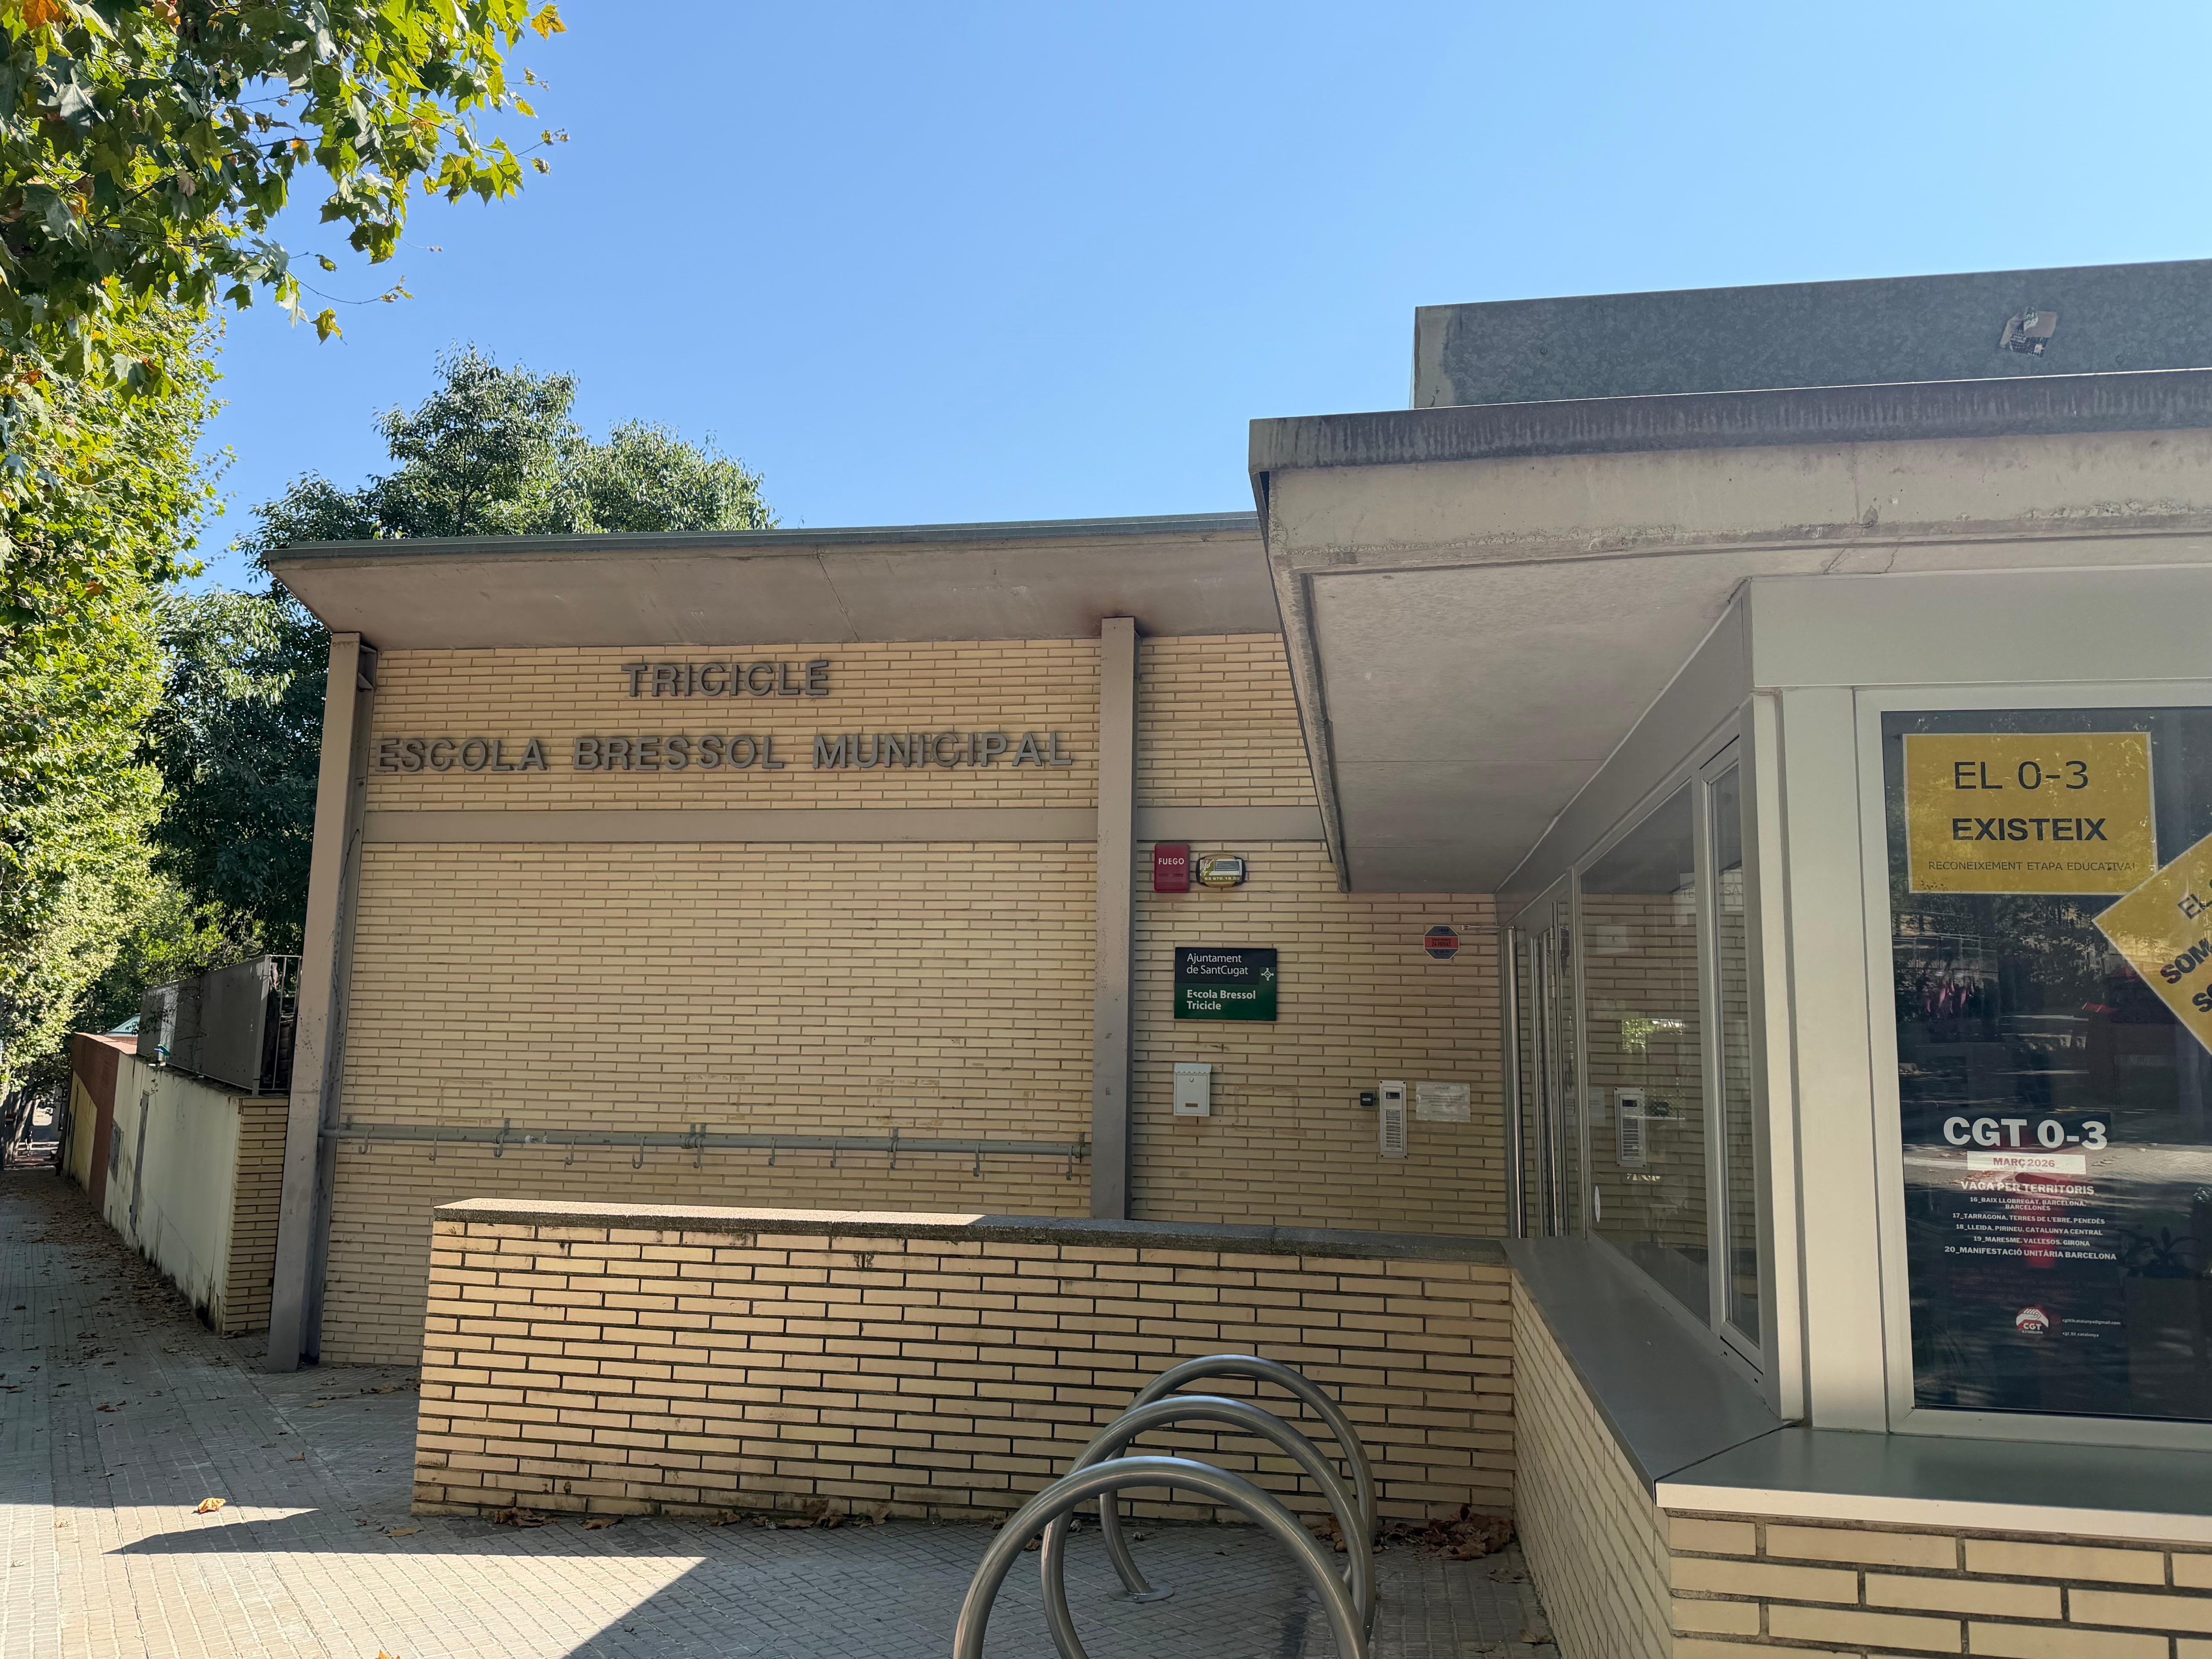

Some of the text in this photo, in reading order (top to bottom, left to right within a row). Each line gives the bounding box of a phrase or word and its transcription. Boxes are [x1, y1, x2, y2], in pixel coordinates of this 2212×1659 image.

[621, 660, 830, 697] TRICICLE
[374, 732, 1074, 772] ESCOLA BRESSOL MUNICIPAL
[1955, 760, 2088, 790] EL 0-3
[1952, 818, 2108, 841] EXISTEIX
[1929, 861, 2135, 871] RECONEIXEMENT ETAPA EDUCATIVA!
[1187, 953, 1242, 964] Ajuntament
[1187, 965, 1249, 977] de SantCugat
[1187, 989, 1255, 999] Escola Bressol
[1187, 1001, 1221, 1010] Tricicle
[1943, 1116, 2107, 1150] CGT 0-3
[1993, 1157, 2055, 1168] MARÇ 2026
[1961, 1181, 2094, 1195] VAGA PER TERRITORIS
[1944, 1246, 2117, 1260] 20_MANIFESTACIÓ UNITÀRIA BARCELONA
